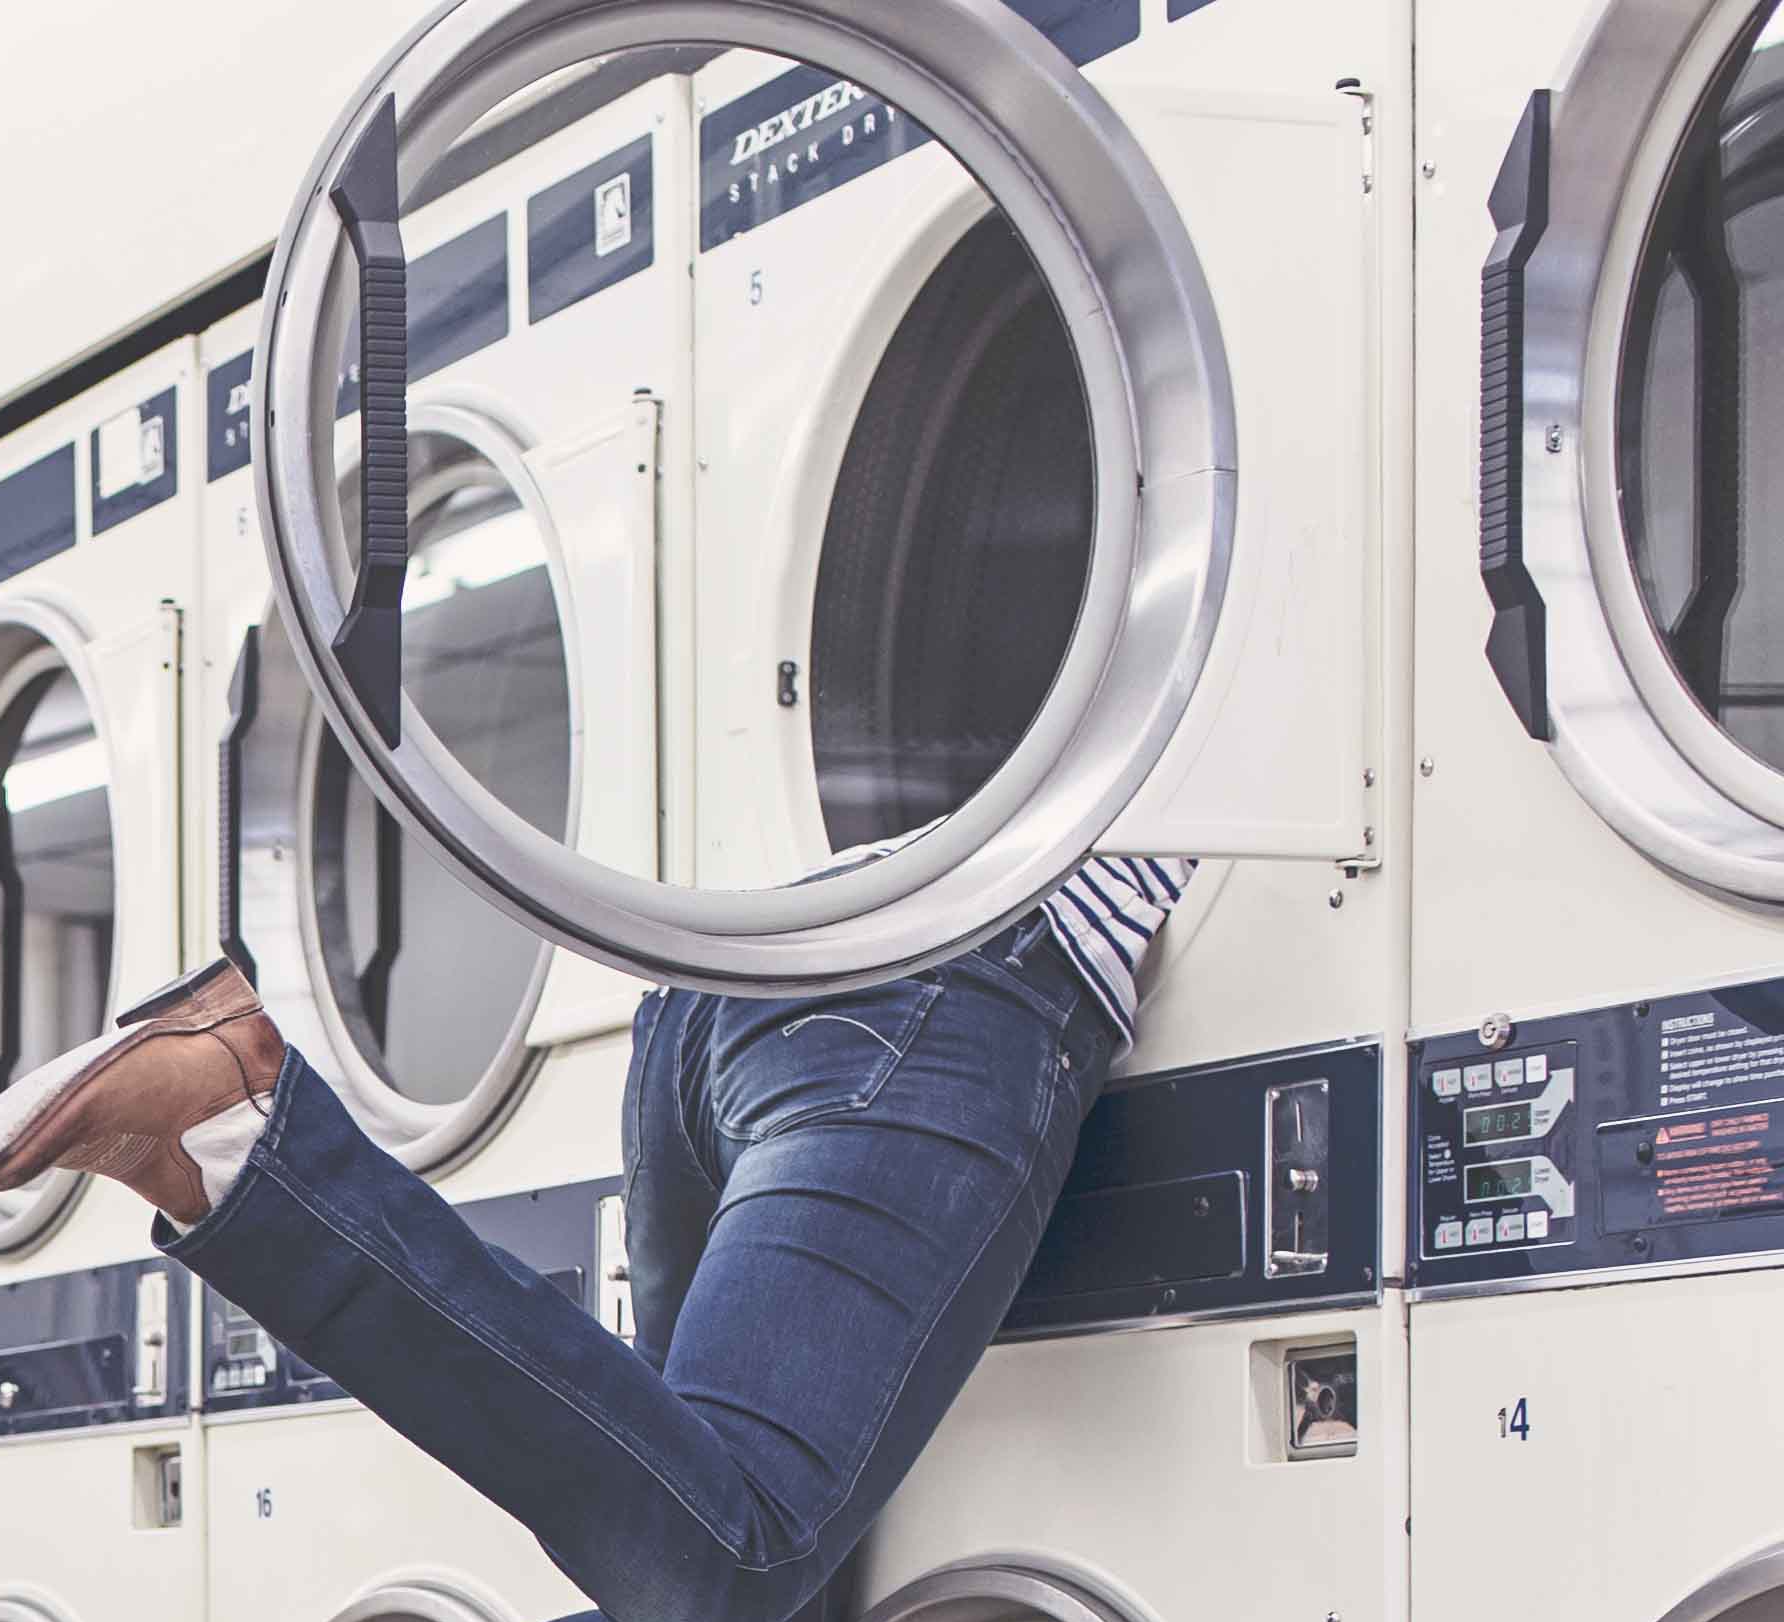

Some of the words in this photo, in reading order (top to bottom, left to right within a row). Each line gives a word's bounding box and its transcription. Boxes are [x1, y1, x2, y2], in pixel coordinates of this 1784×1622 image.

[729, 80, 865, 166] DEXTER
[729, 141, 820, 203] STACK
[1497, 1397, 1530, 1441] 14
[256, 1488, 272, 1519] 16
